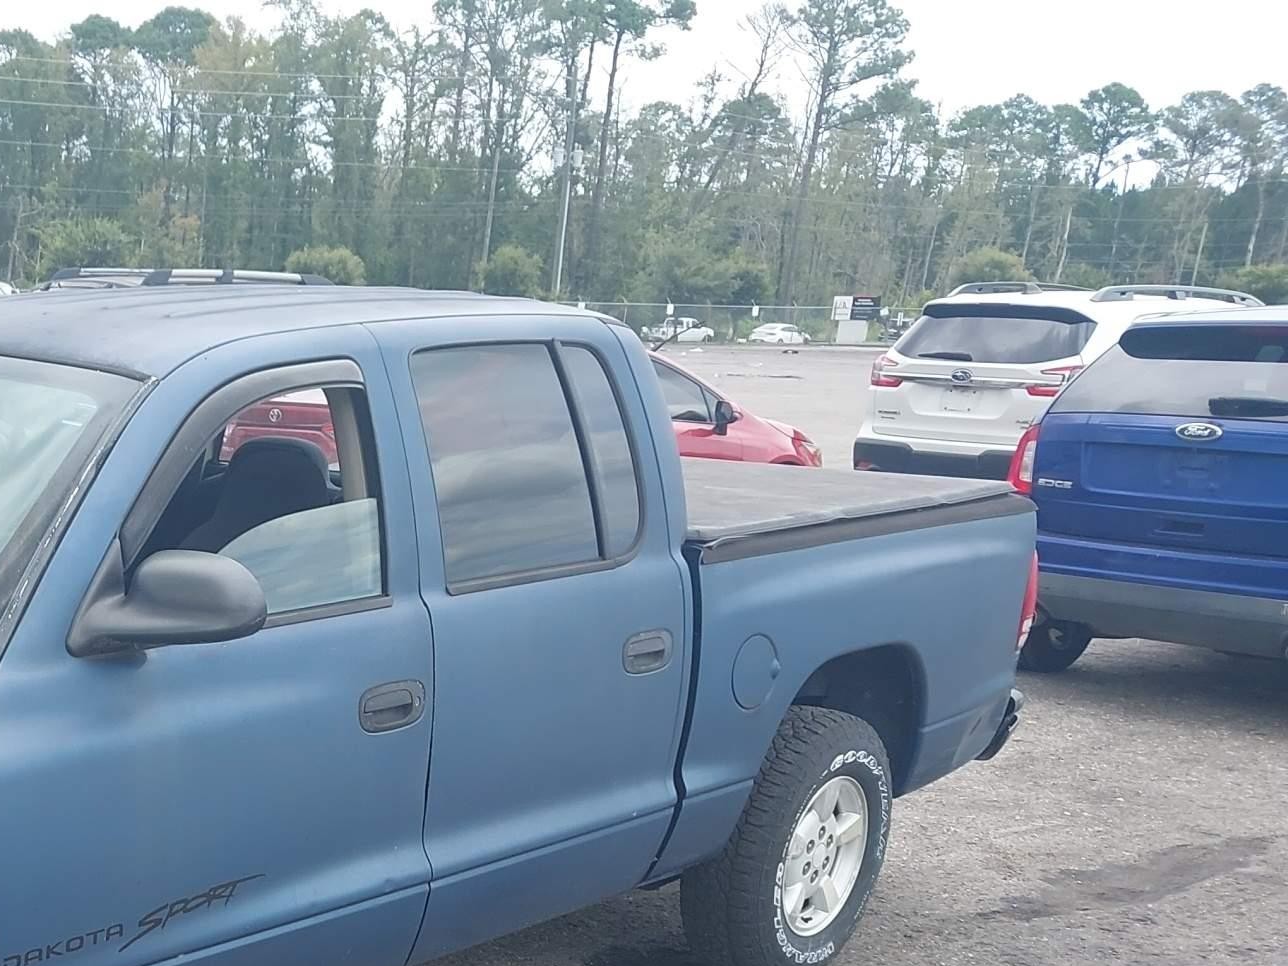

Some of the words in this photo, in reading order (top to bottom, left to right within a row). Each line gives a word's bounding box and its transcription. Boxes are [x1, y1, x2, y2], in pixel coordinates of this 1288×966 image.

[1184, 425, 1212, 437] Ford
[1038, 478, 1073, 489] EDGE
[118, 873, 266, 953] SPORT
